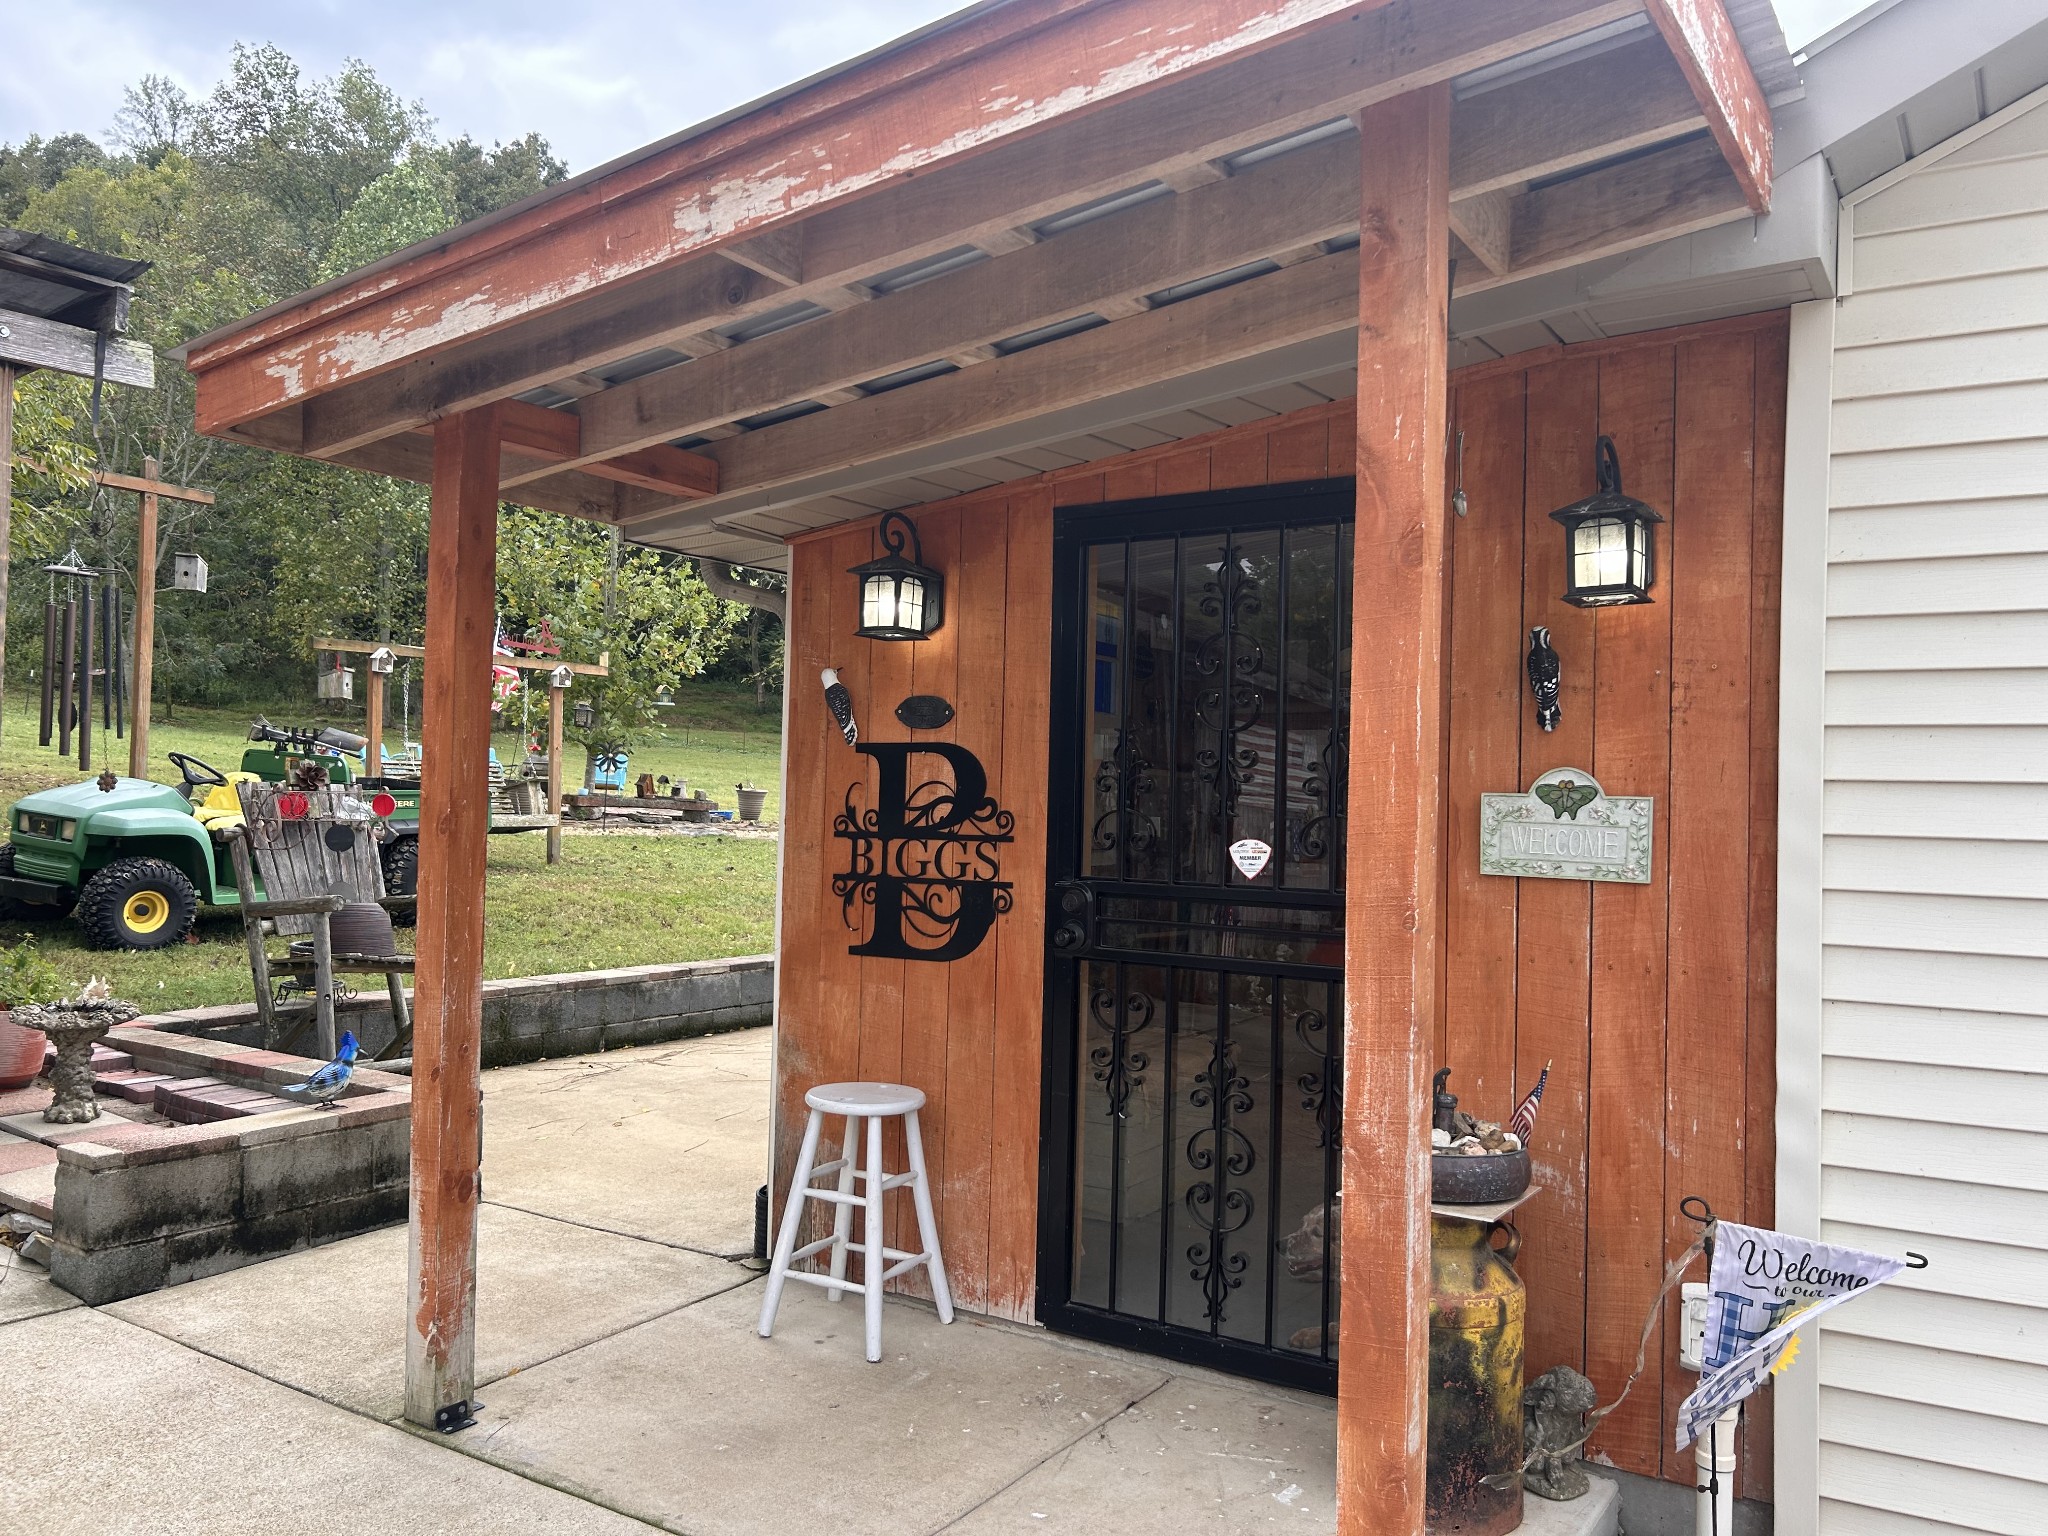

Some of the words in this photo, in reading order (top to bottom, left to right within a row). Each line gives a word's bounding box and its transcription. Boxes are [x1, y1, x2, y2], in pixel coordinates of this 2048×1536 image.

[849, 836, 999, 882] BIGGS
[1509, 825, 1619, 859] WELCOME
[1737, 1239, 1868, 1291] Welcome
[1774, 1285, 1787, 1298] to
[1792, 1286, 1825, 1298] our
